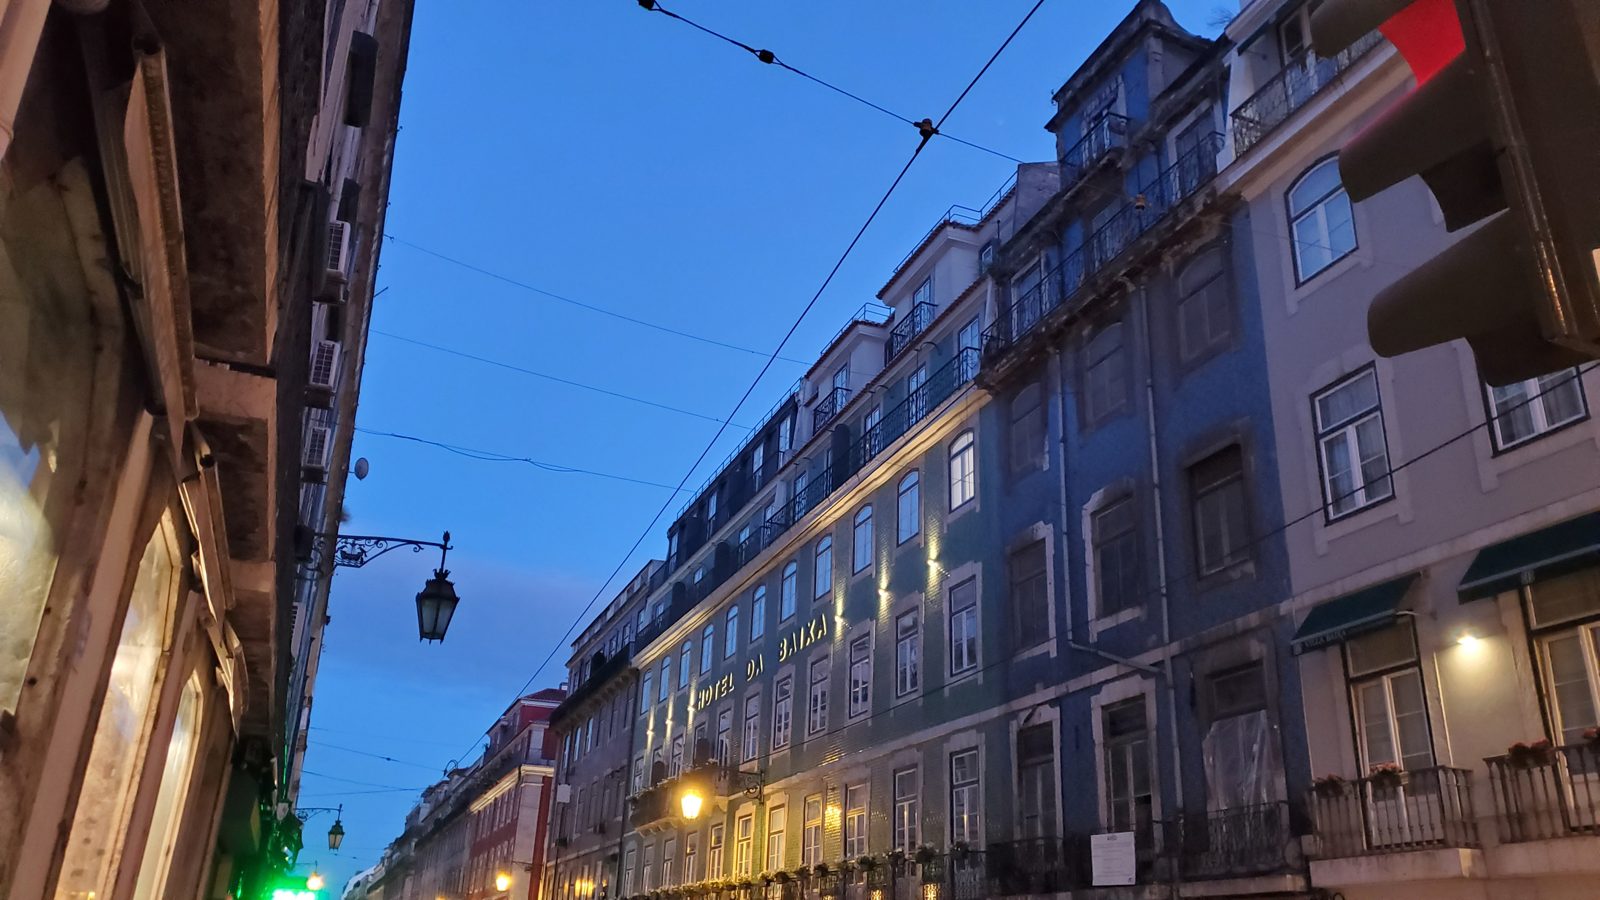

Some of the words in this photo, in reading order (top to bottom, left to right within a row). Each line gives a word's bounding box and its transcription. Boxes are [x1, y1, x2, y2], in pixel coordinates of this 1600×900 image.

[698, 672, 735, 710] HOTEL
[746, 653, 764, 681] DA
[779, 613, 827, 662] BAIXA
